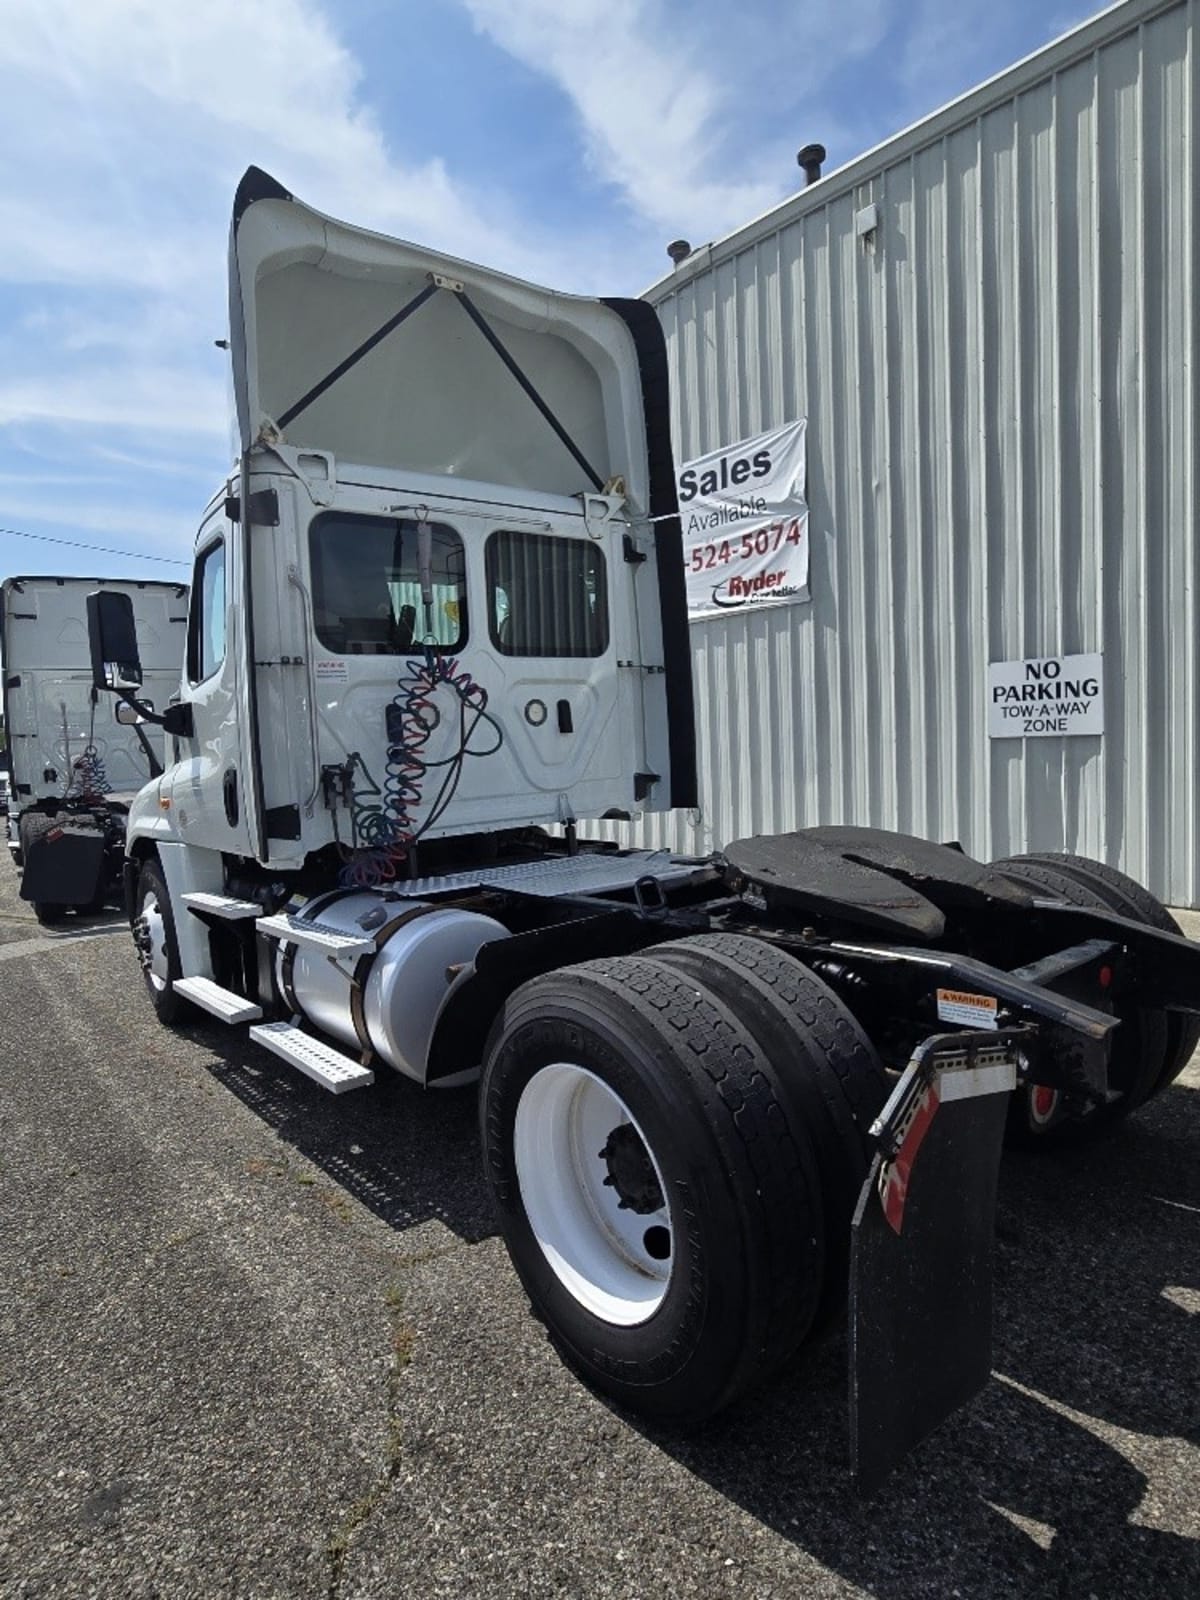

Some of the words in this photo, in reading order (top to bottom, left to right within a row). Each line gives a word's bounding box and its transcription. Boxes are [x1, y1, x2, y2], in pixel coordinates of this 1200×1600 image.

[679, 450, 772, 502] Sales
[687, 496, 768, 535] Available
[728, 569, 788, 598] Ryder
[1026, 660, 1060, 680] NO
[993, 678, 1099, 703] PARKING
[1000, 700, 1091, 718] TOW-A-WAY
[1023, 718, 1068, 732] ZONE
[950, 993, 990, 1007] WARNING
